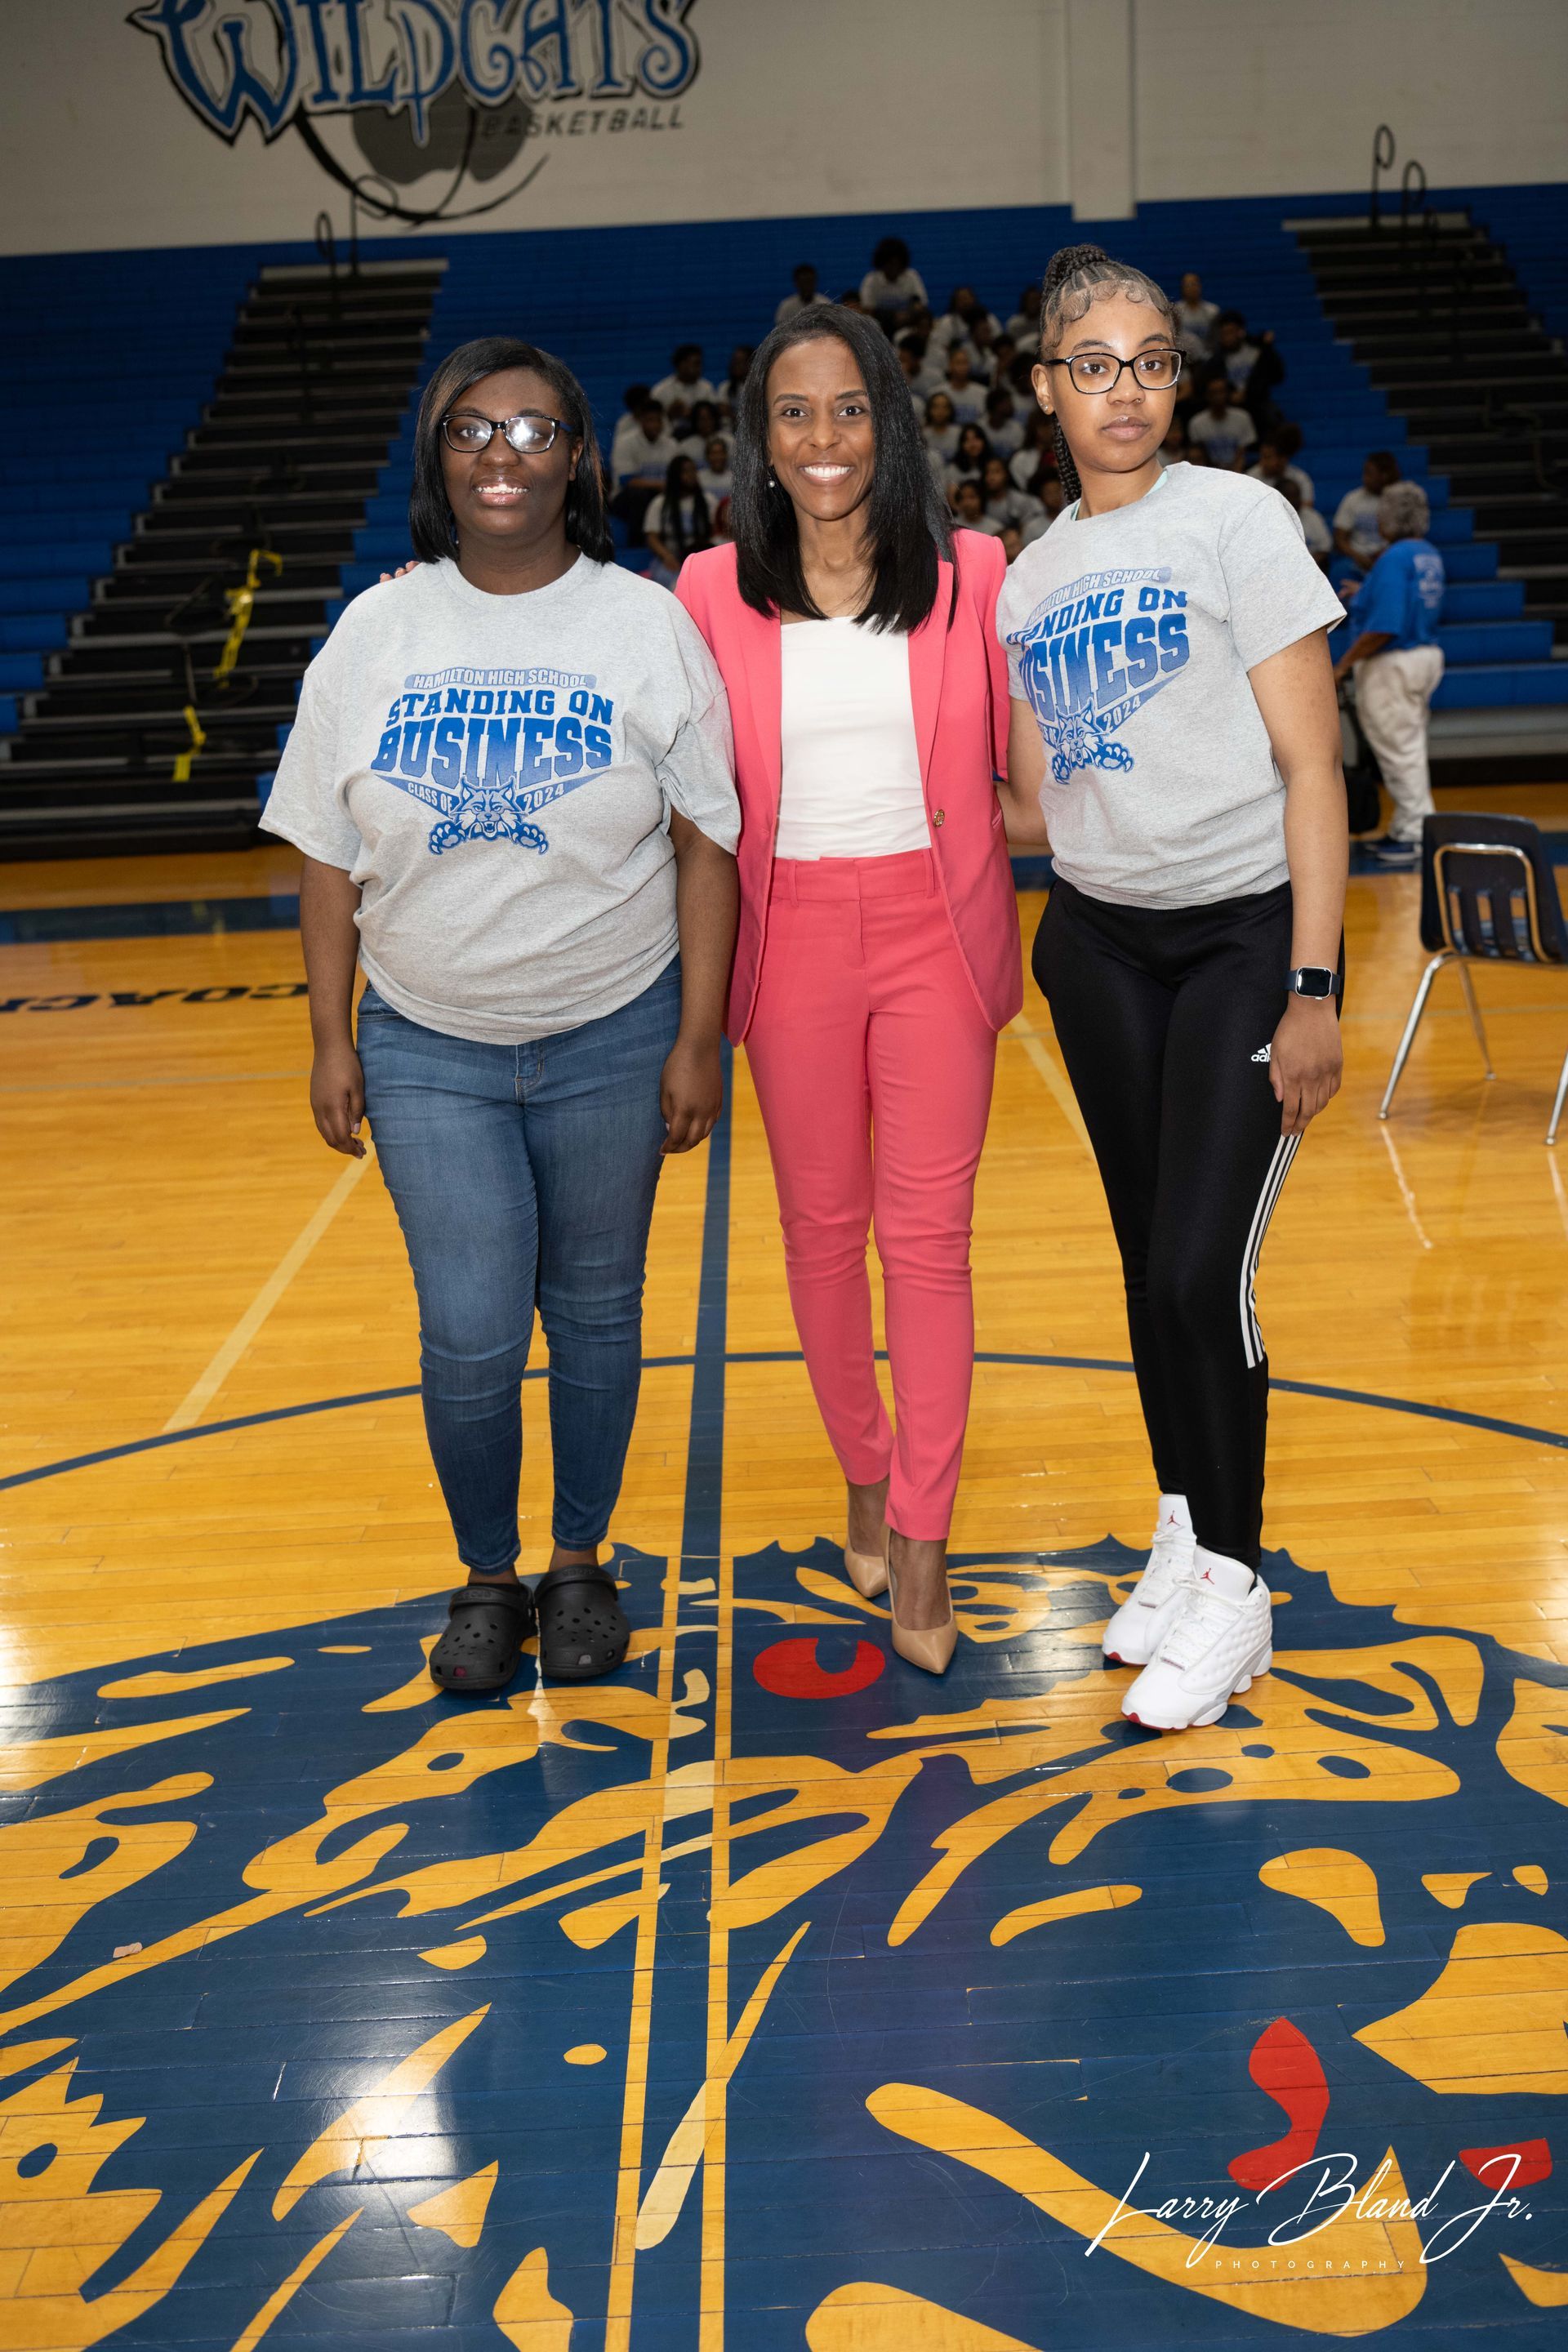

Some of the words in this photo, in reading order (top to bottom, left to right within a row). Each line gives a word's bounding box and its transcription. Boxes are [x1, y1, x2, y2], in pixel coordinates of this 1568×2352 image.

[481, 105, 684, 139] BASKETBALL
[1029, 585, 1071, 625] HAMILTON
[1072, 574, 1102, 598] HIGH
[1102, 568, 1160, 587] SCHOOL
[1138, 586, 1188, 612] ON
[413, 668, 485, 688] HAMILTON
[487, 670, 525, 686] HIGH
[528, 670, 588, 688] SCHOOL
[1018, 612, 1190, 722] USINESS
[385, 688, 555, 728] STANDING
[568, 690, 614, 725] ON
[1103, 697, 1142, 733] 2024
[370, 716, 612, 790] BUSINESS
[408, 783, 438, 806] CLASS
[439, 795, 453, 813] OF
[523, 782, 566, 813] 2024
[1250, 1052, 1272, 1062] adi
